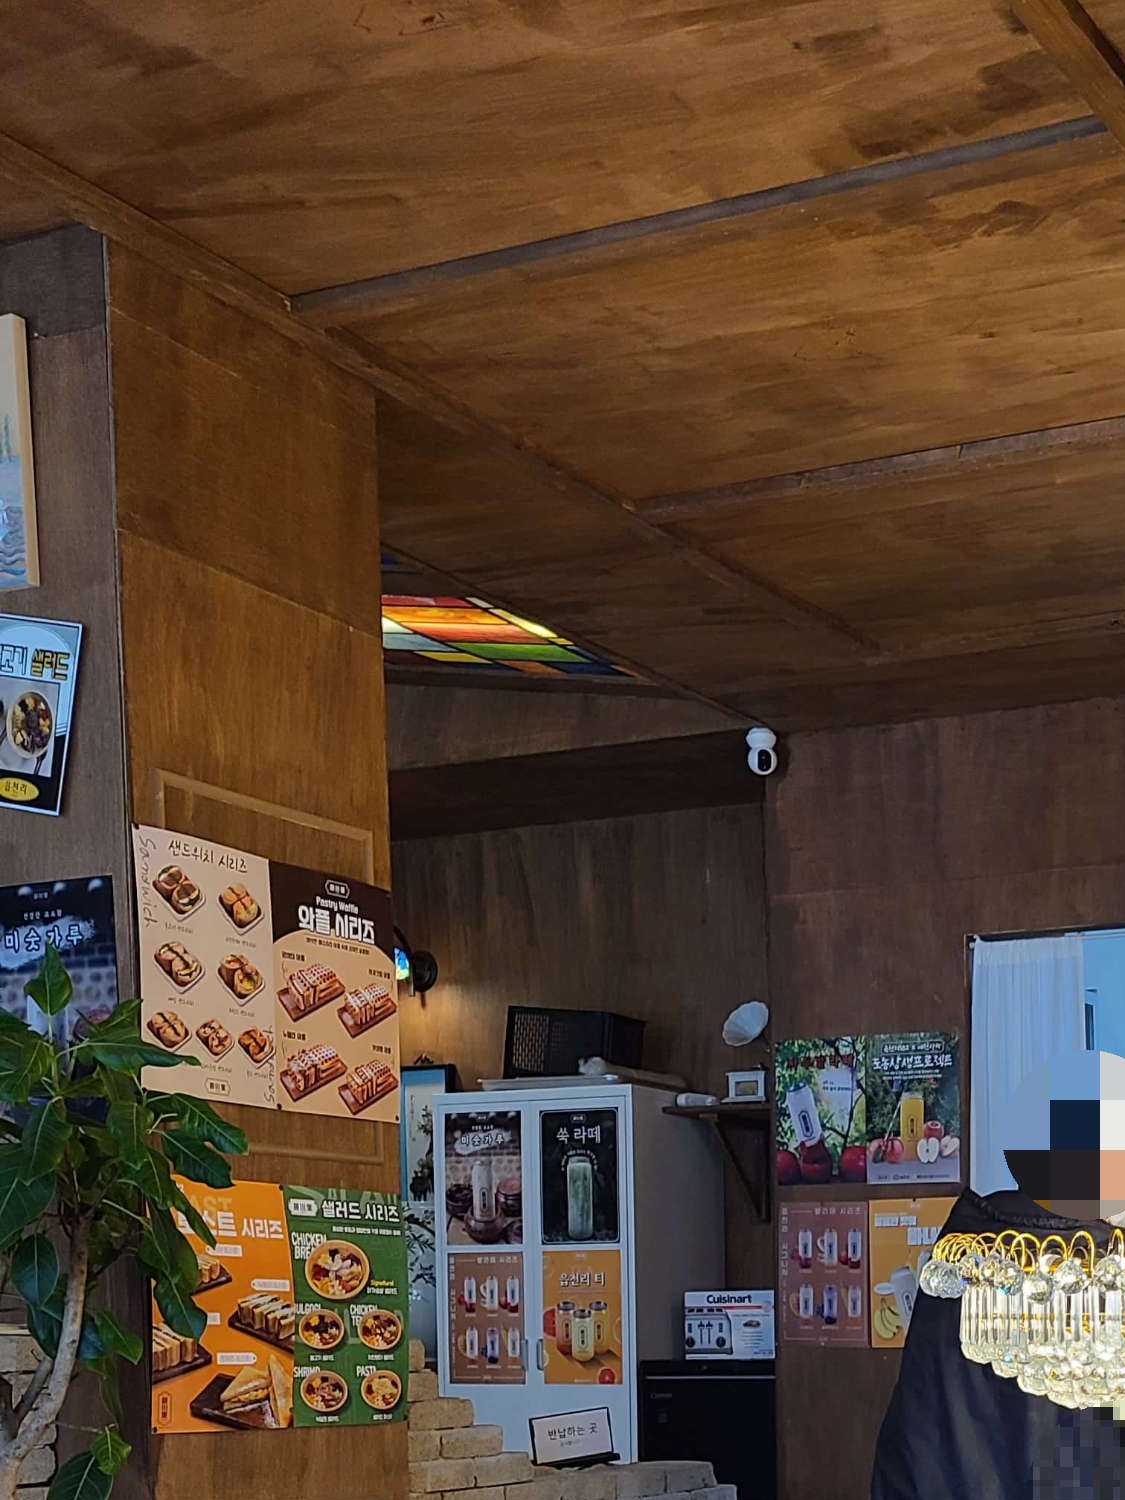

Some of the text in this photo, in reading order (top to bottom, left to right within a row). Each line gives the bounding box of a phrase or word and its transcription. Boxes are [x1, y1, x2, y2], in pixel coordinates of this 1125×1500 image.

[0, 643, 71, 681] 고기 샐러드
[4, 780, 28, 795] 읍천리
[168, 839, 248, 873] 샌드위치 시리즈
[297, 905, 375, 945] 와플 시리즈
[4, 924, 83, 954] 미숫가루
[556, 1125, 601, 1145] 쑥 라떼
[321, 1200, 362, 1220] 샐러드
[365, 1203, 400, 1222] 시리즈
[242, 1217, 284, 1239] 시리즈
[291, 1231, 327, 1247] CHICKEN
[706, 1294, 752, 1304] Cuisinart
[548, 1422, 598, 1440] 반납하는 곳
